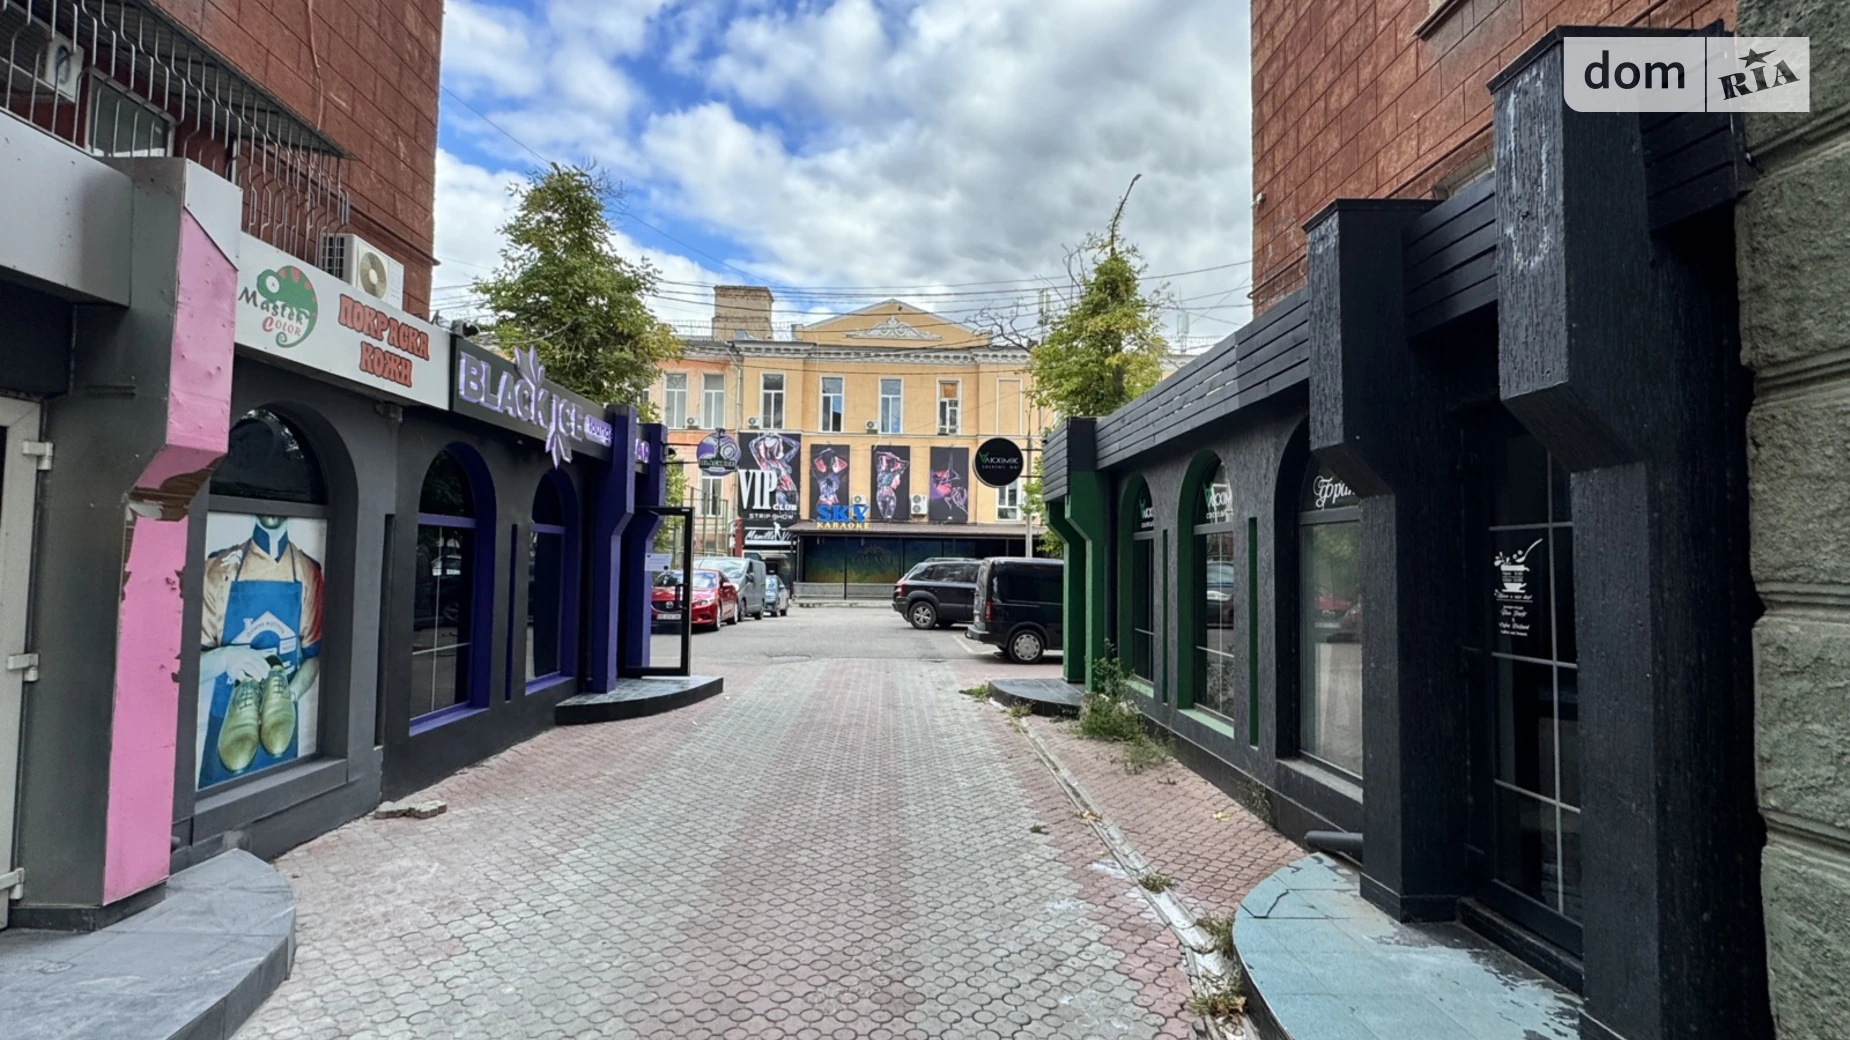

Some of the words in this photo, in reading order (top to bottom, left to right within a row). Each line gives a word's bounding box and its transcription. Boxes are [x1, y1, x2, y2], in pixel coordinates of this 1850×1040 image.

[338, 294, 430, 361] ПОКРАСКА
[359, 341, 412, 388] КОЖИ
[459, 351, 549, 430] BLACK
[738, 469, 777, 509] VIP
[772, 503, 798, 511] CLUB
[816, 504, 869, 523] SKY
[816, 521, 871, 530] KARAOKE
